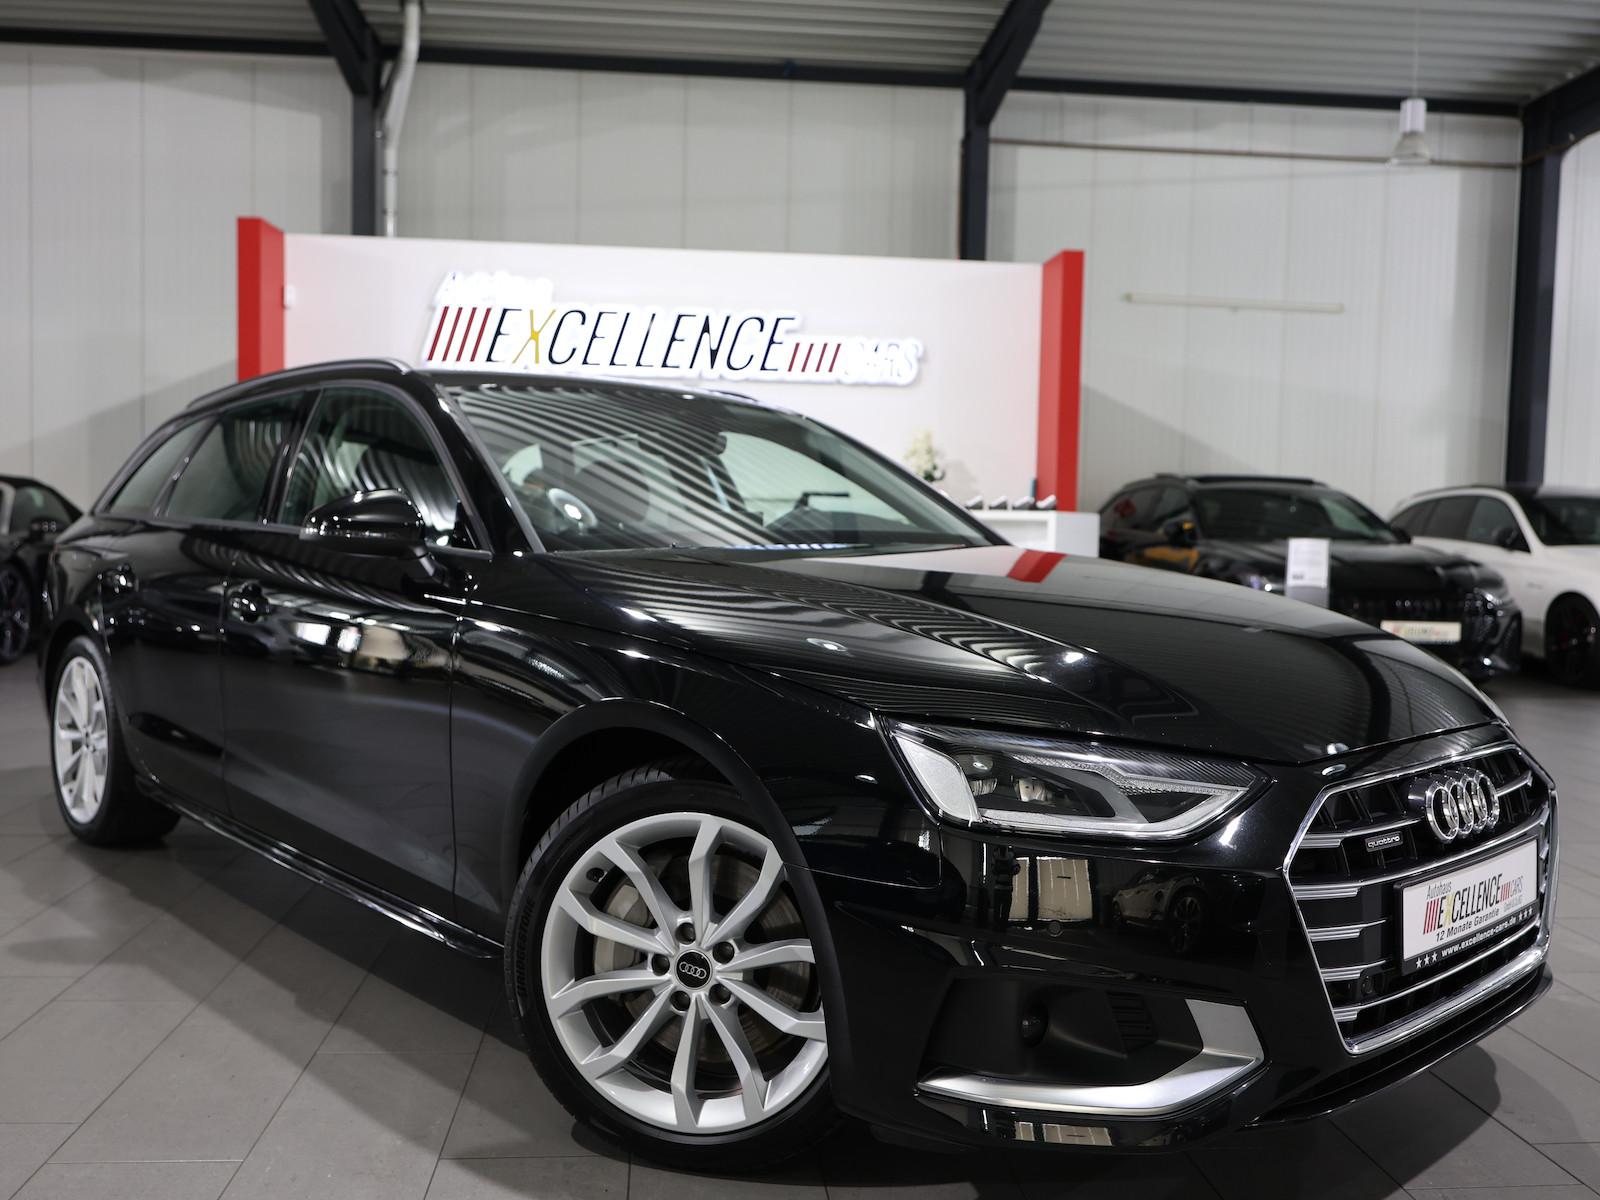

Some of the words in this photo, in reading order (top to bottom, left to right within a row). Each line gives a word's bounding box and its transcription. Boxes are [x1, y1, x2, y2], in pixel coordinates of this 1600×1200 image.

[485, 307, 796, 373] EXCELLENCE
[1367, 834, 1401, 848] quattro
[1426, 880, 1453, 901] Autohaus
[1437, 873, 1503, 929] EXCELLENCE
[1436, 930, 1446, 943] 12
[1446, 920, 1473, 938] Monate
[1473, 907, 1500, 926] Garantie
[1441, 916, 1517, 957] www.excellence-cars.de
[516, 897, 535, 998] BRIDGESTONE
